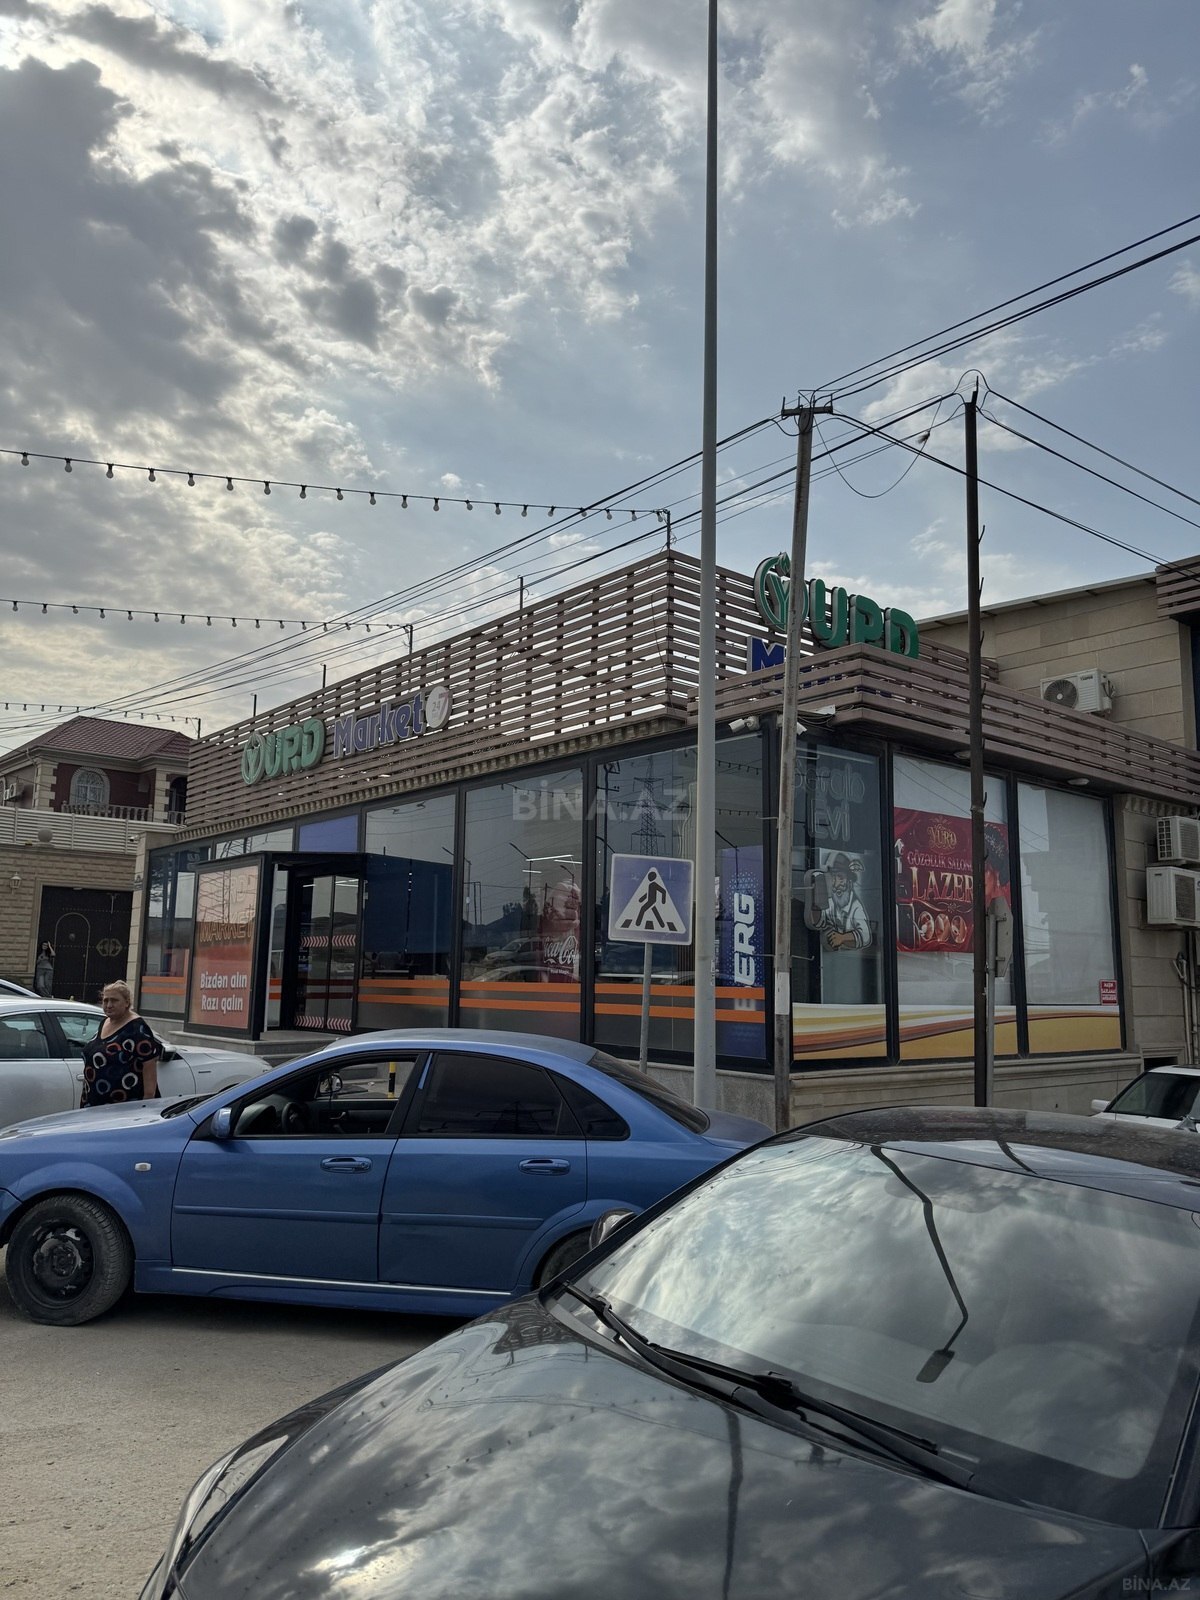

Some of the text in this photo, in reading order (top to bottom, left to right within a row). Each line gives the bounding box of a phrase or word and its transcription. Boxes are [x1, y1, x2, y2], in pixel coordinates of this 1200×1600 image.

[334, 691, 425, 759] Market
[910, 866, 973, 903] LAZER
[200, 972, 247, 989] Bizdən alın
[201, 994, 243, 1014] Razı qalın
